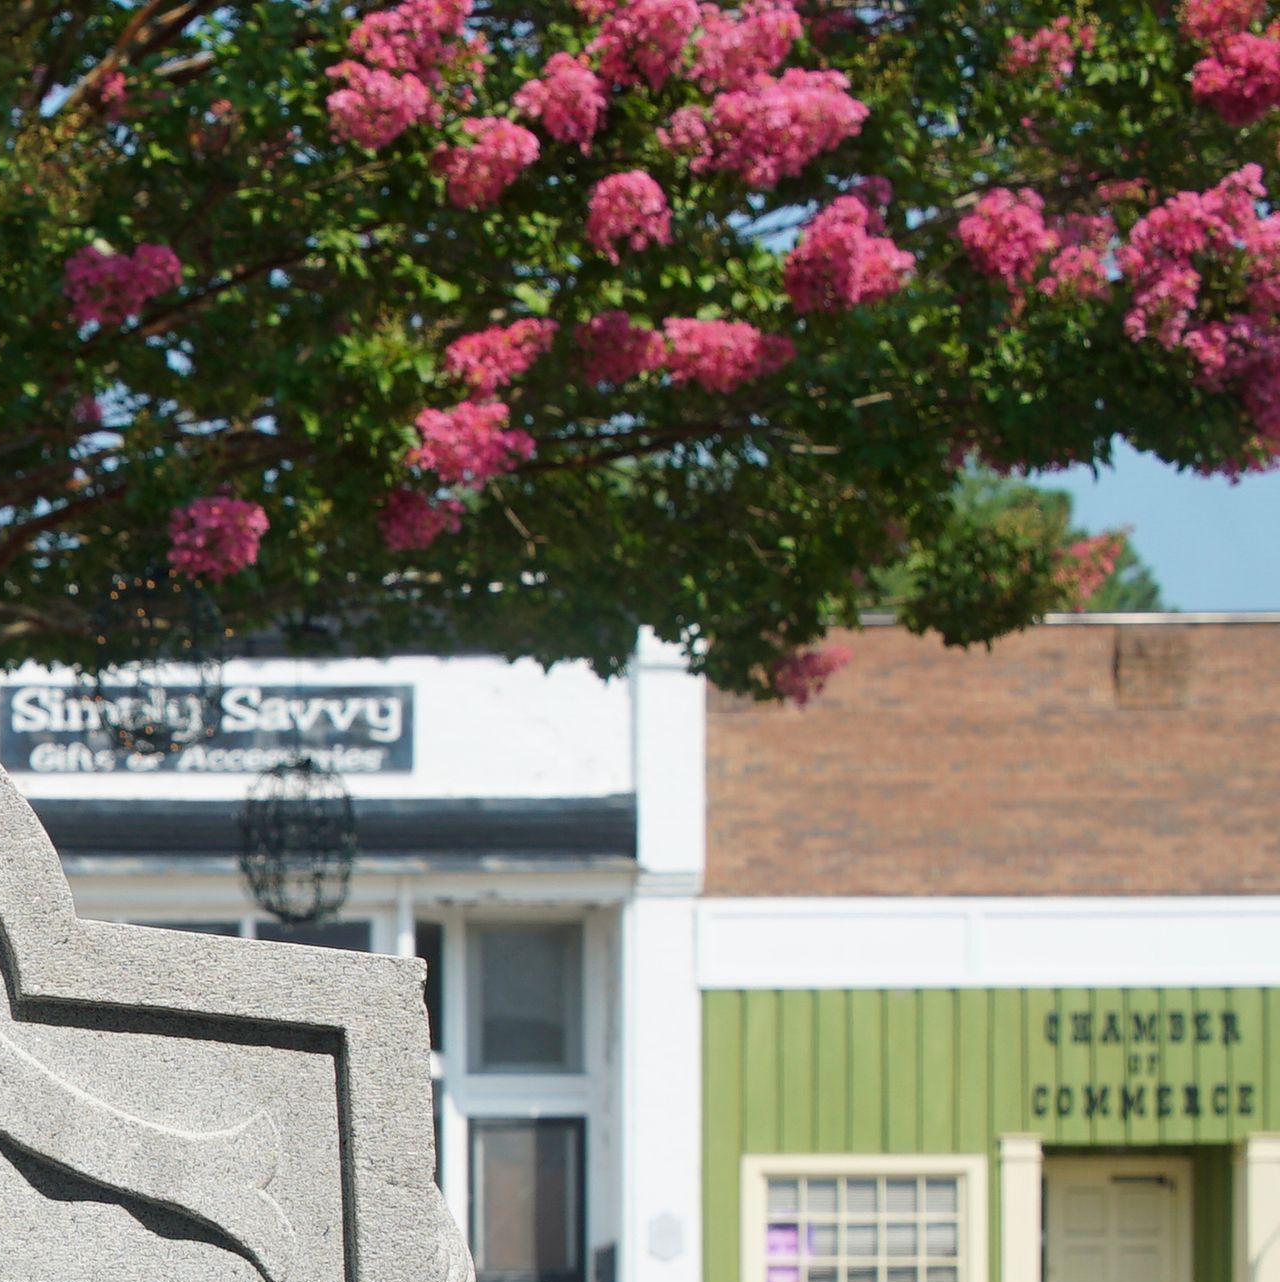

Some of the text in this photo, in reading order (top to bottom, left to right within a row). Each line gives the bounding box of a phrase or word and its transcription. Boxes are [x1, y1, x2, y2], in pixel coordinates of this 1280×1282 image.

[221, 686, 404, 743] Savvy
[1044, 1011, 1242, 1045] CHAMBER
[1127, 1052, 1160, 1076] OF
[1032, 1082, 1255, 1118] COMMERCE
